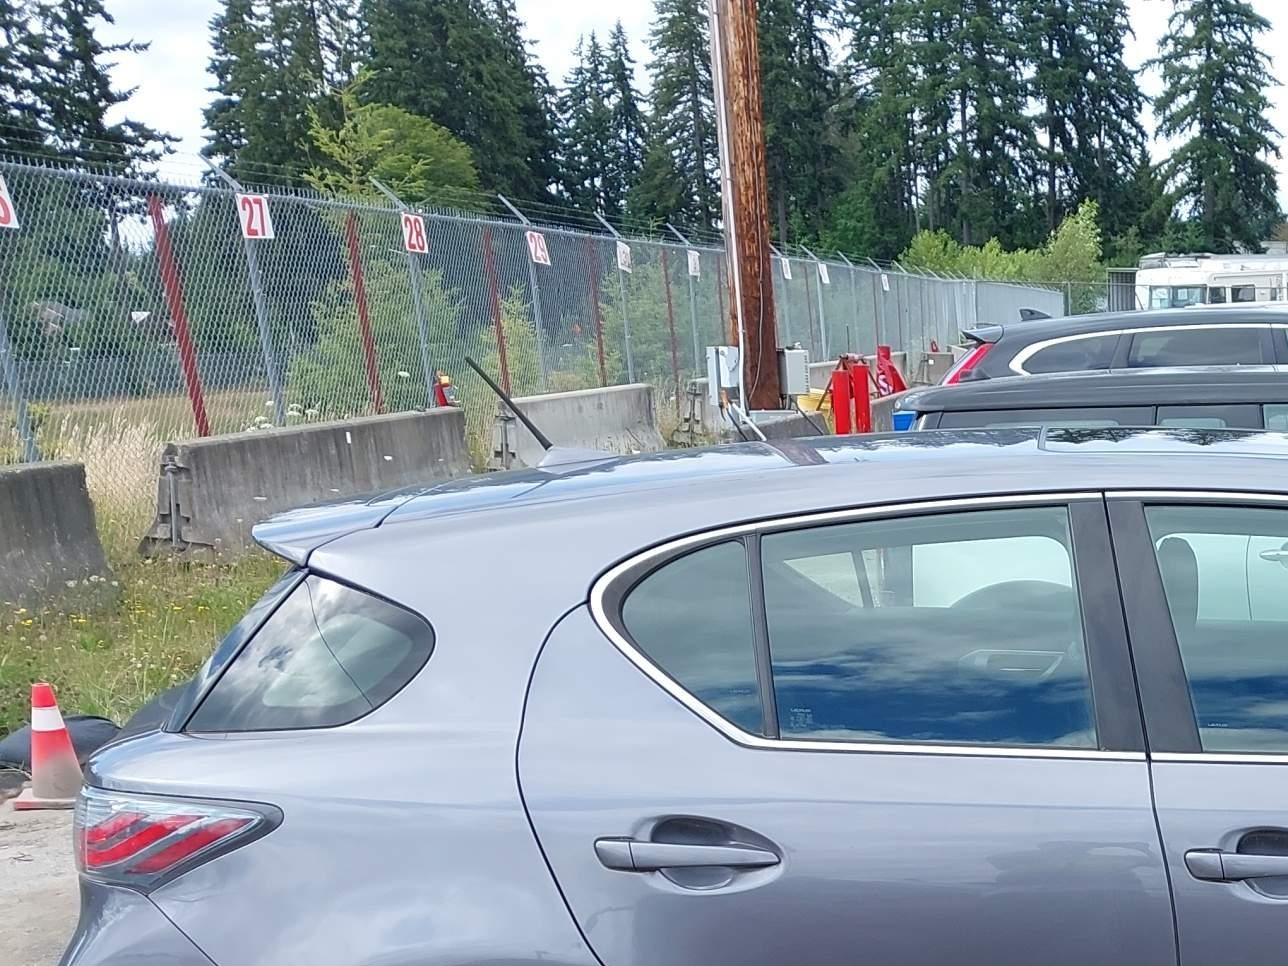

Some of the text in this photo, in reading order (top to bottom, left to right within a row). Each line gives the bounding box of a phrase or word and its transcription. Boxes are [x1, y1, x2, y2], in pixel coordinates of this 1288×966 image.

[241, 196, 266, 237] 27
[404, 215, 426, 252] 28
[530, 235, 549, 264] 29
